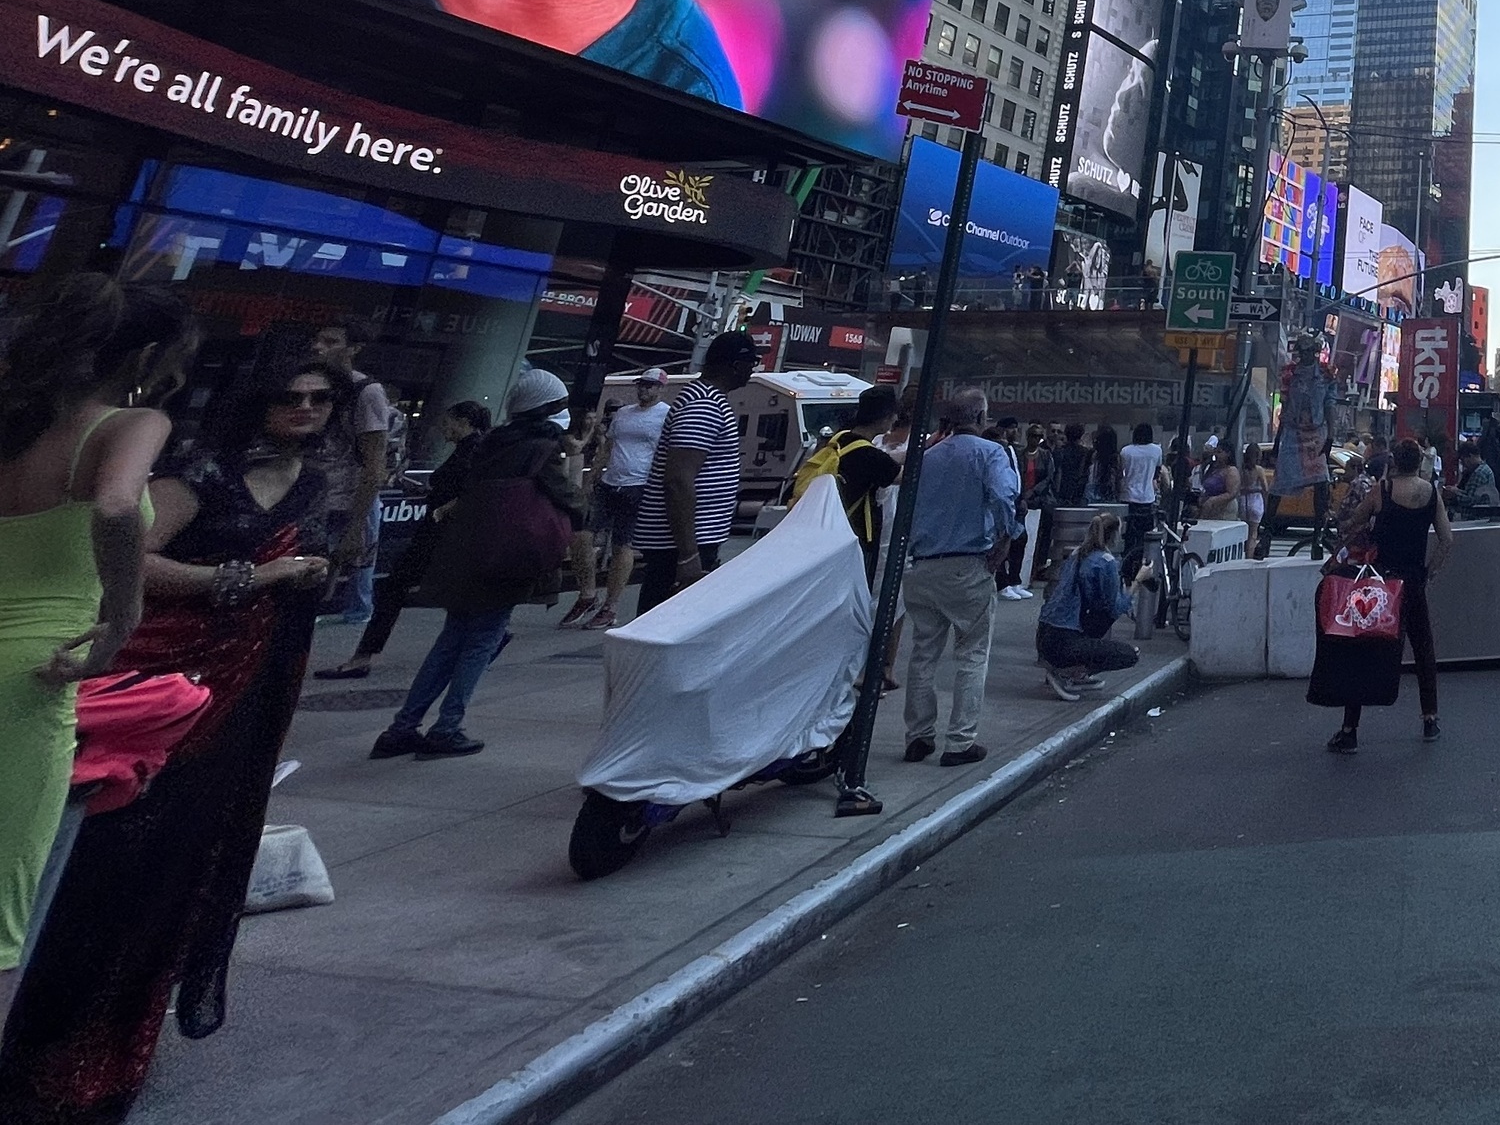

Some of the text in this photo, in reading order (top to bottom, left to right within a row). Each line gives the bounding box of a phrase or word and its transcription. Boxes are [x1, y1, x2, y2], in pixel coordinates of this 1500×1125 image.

[37, 14, 161, 93] We're
[166, 71, 222, 113] all
[225, 85, 341, 154] family
[907, 65, 975, 91] NO STOPPING
[1063, 51, 1079, 91] SCHUTZ
[906, 78, 948, 98] Anytime
[1054, 102, 1071, 144] SCHUTZ
[1048, 156, 1063, 189] HUTZ
[1077, 156, 1113, 186] SCHUTZ
[620, 175, 680, 201] Olive
[623, 194, 708, 224] Garden
[965, 221, 1000, 241] Channel
[1000, 231, 1030, 249] Outdoor
[1358, 230, 1367, 244] OF
[1359, 215, 1375, 235] FACE
[1356, 258, 1380, 279] FUTURE
[1368, 248, 1380, 265] THE
[1176, 286, 1226, 302] South
[1249, 304, 1271, 315] WAY
[1413, 325, 1449, 401] tkts
[381, 499, 428, 524] ubw
